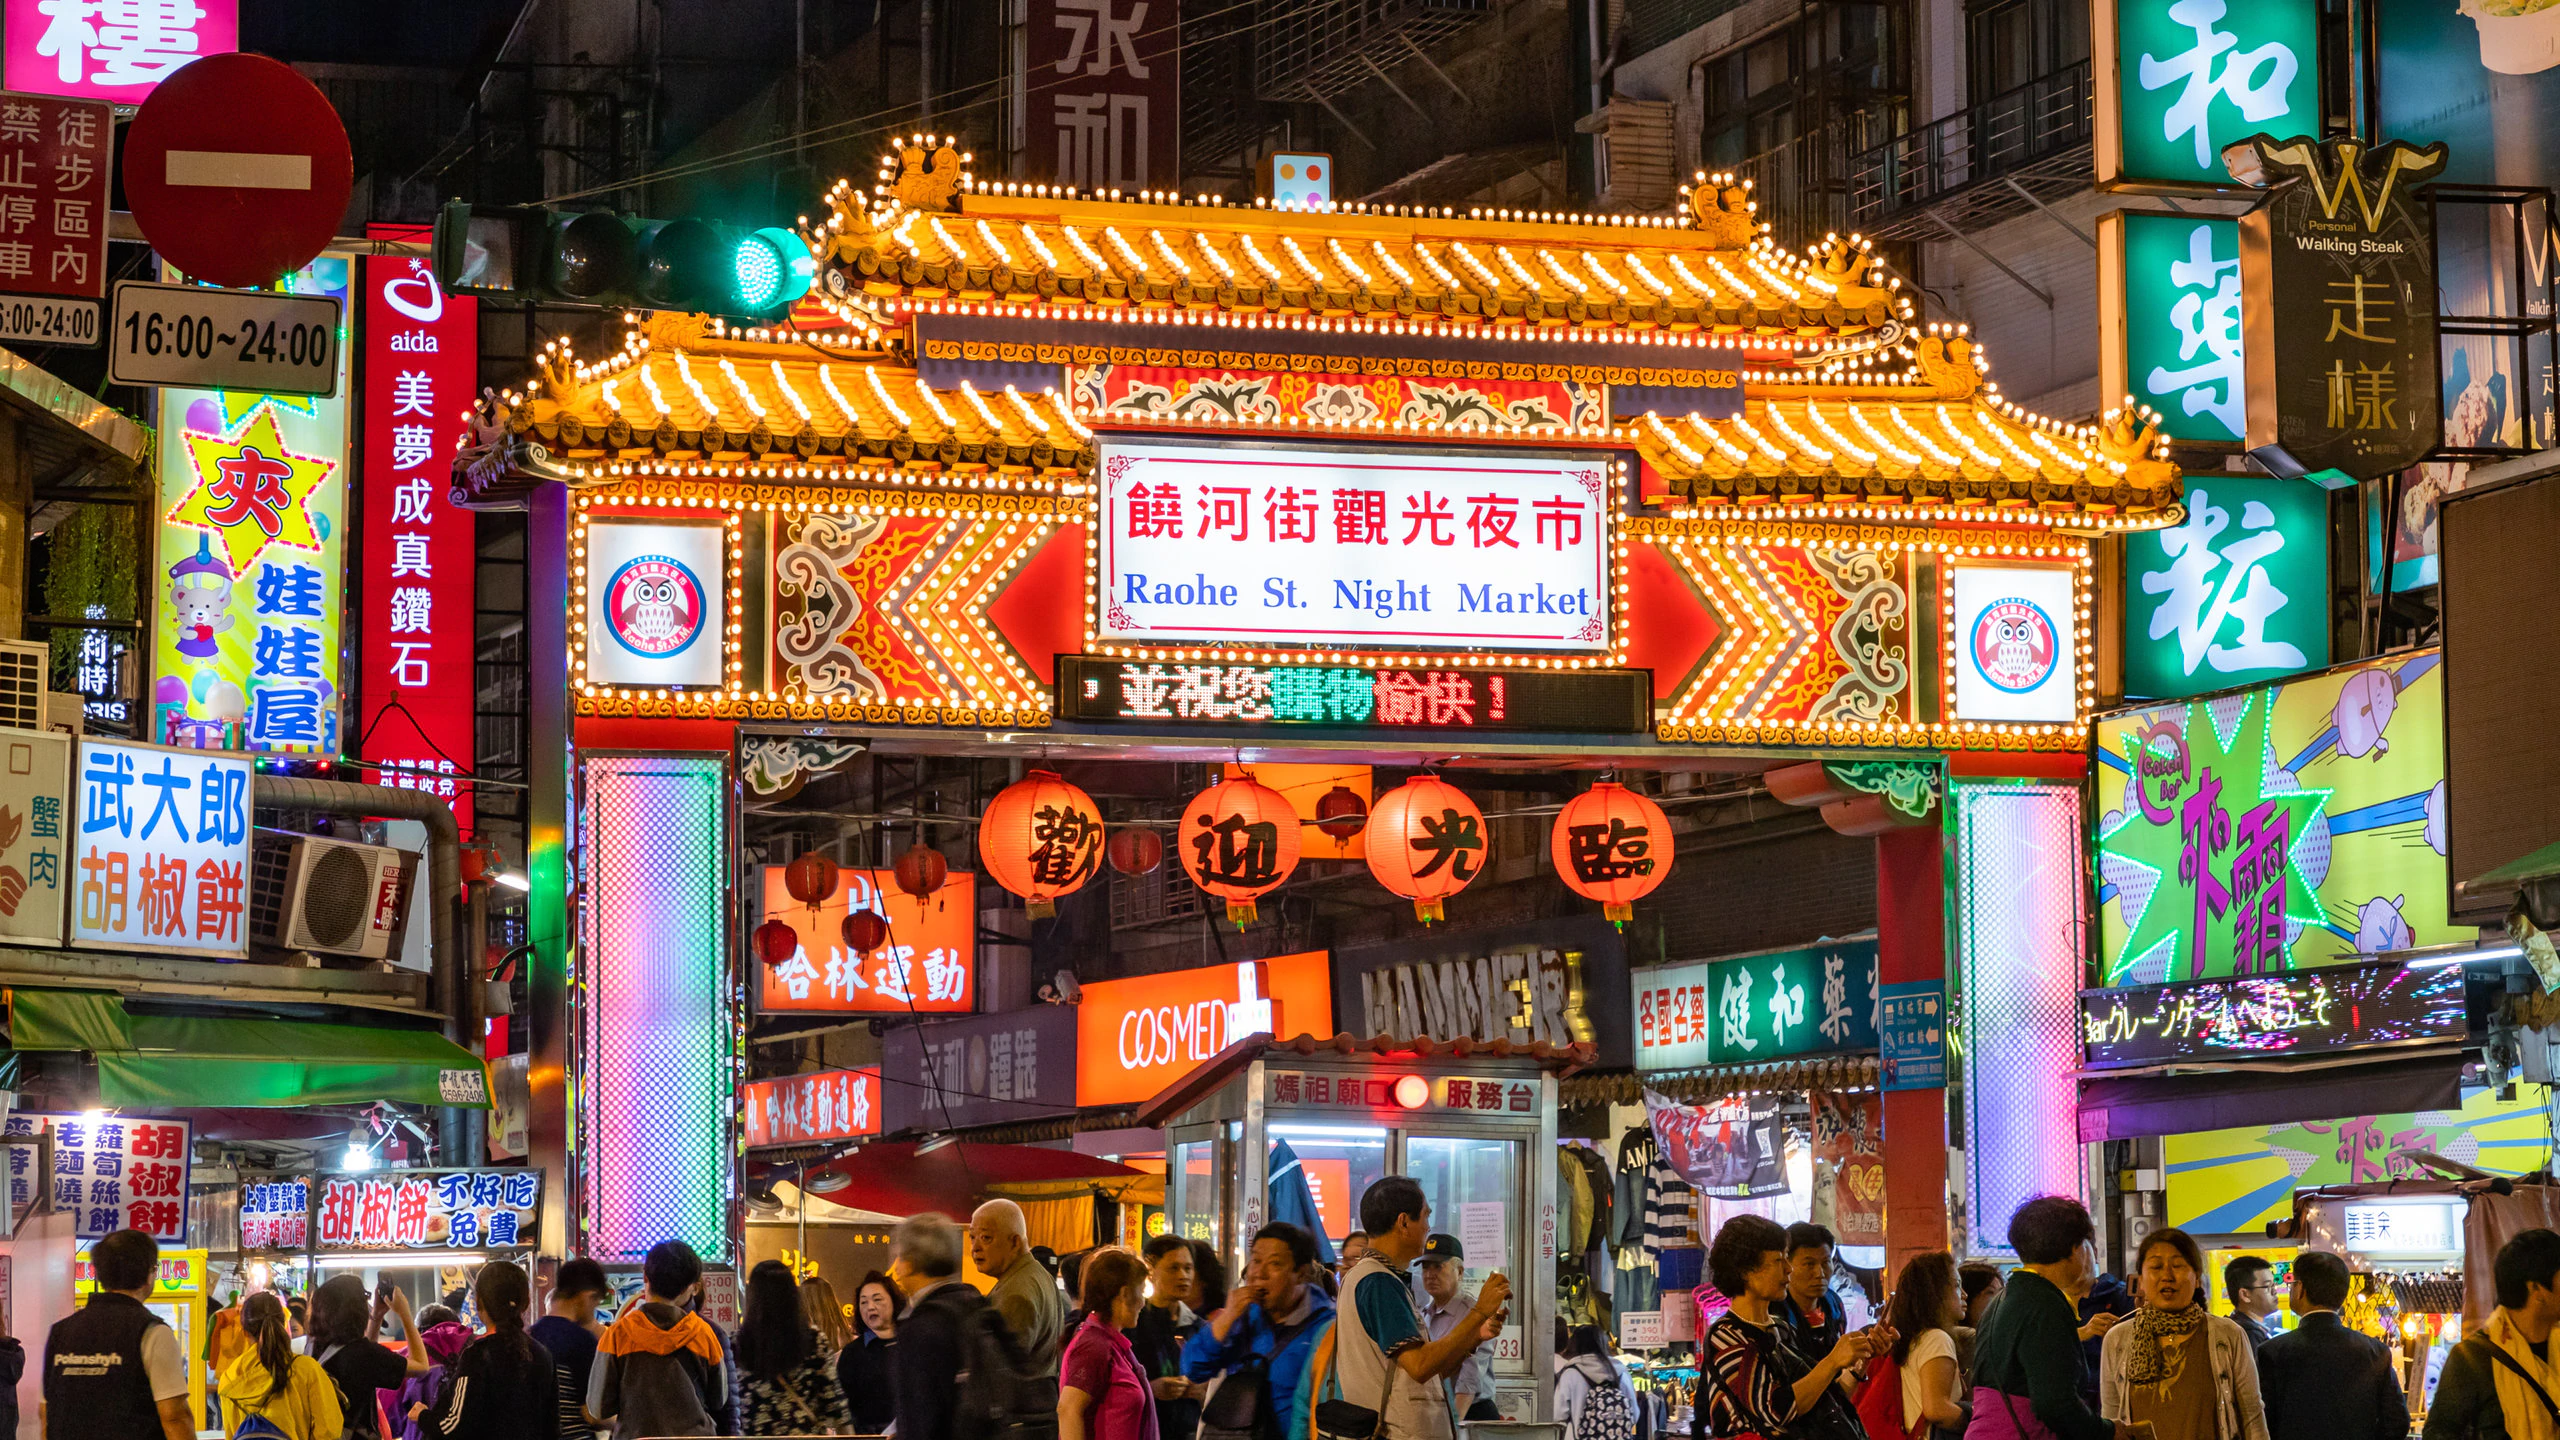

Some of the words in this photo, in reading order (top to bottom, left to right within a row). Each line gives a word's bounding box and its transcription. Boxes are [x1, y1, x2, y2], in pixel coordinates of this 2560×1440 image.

[36, 0, 206, 85] 樓
[1054, 0, 1150, 190] 永和
[0, 102, 41, 280] 禁止停車
[51, 106, 97, 285] 徒步區內
[2308, 219, 2357, 233] Personal
[2296, 236, 2357, 255] Walking
[2360, 240, 2404, 254] Steak
[124, 311, 327, 368] 16:00~24:00
[391, 331, 438, 353] aida
[2323, 274, 2398, 431] 走樣
[205, 446, 294, 537] 夾
[1126, 480, 1587, 552] 饒河街觀光夜市
[390, 371, 433, 688] 美夢成真鑽石
[1124, 572, 1239, 608] Raohe
[1263, 577, 1308, 609] St.
[1333, 577, 1432, 619] Night
[1458, 581, 1591, 617] Market
[253, 563, 325, 743] 娃娃屋
[83, 752, 247, 847] 武大郎
[30, 796, 61, 889] 蟹肉
[1029, 804, 1104, 889] 歡
[1193, 813, 1285, 891] 迎
[1409, 809, 1484, 881] 光
[1568, 817, 1654, 883] 臨
[80, 845, 244, 943] 胡椒餅
[776, 946, 966, 1003] 哈林運動
[1118, 999, 1229, 1070] COSMED
[1640, 983, 1705, 1048] 各國名藥
[766, 1075, 870, 1138] 哈林運動通路
[1273, 1073, 1390, 1107] 媽祖廟口
[1447, 1079, 1535, 1113] 服務台
[126, 1124, 184, 1236] 胡椒餅
[243, 1183, 307, 1214] 上海蟹殼黃
[322, 1179, 432, 1244] 胡椒餅
[438, 1174, 535, 1209] 不好吃
[448, 1211, 517, 1245] 免費
[1542, 1204, 1555, 1260] 小心扒手
